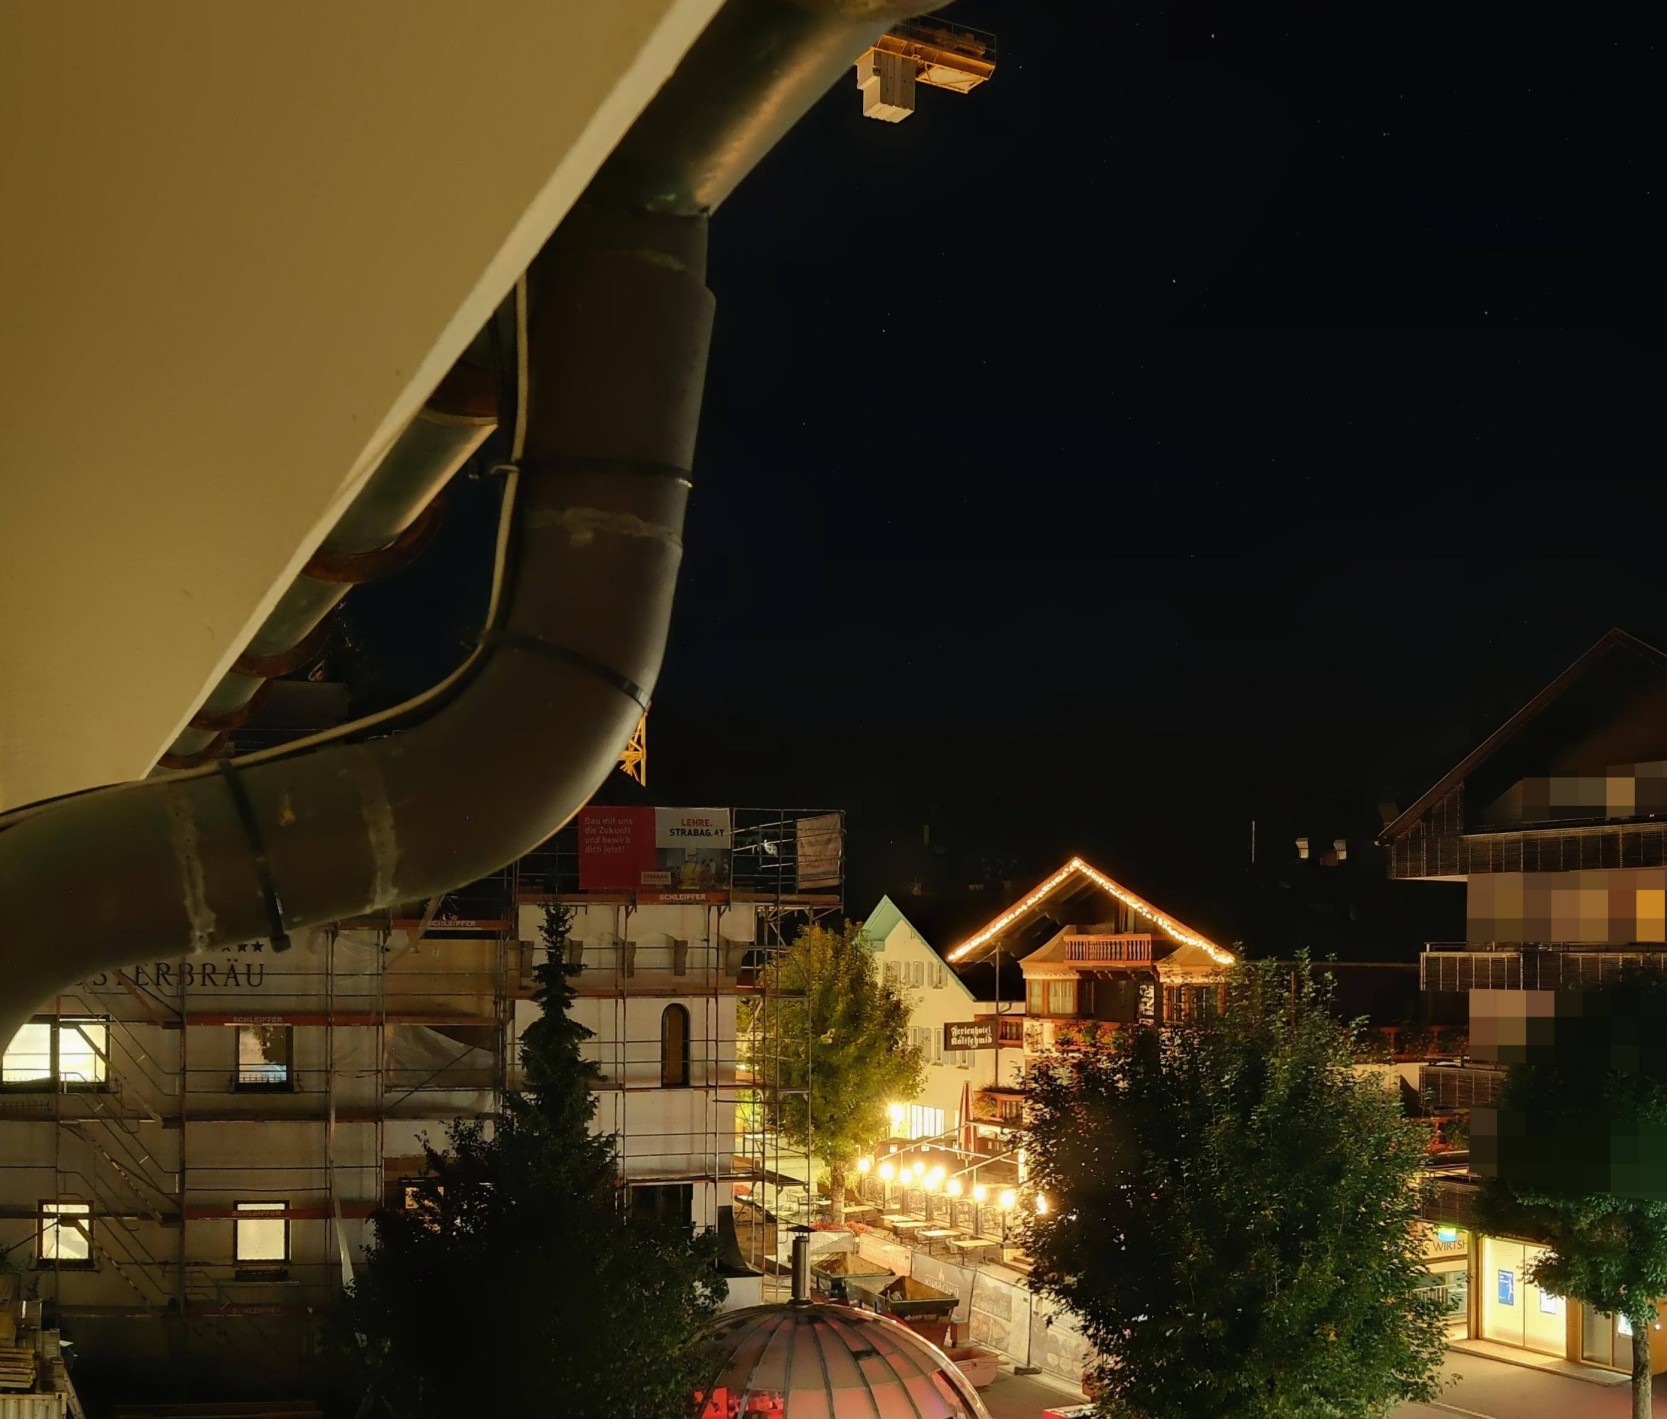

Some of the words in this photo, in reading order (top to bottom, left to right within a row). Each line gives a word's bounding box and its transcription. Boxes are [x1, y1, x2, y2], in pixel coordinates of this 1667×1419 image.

[681, 818, 713, 827] LEHRE.
[659, 893, 706, 901] SCHLEIPFER
[950, 1024, 991, 1037] Ferienhotel
